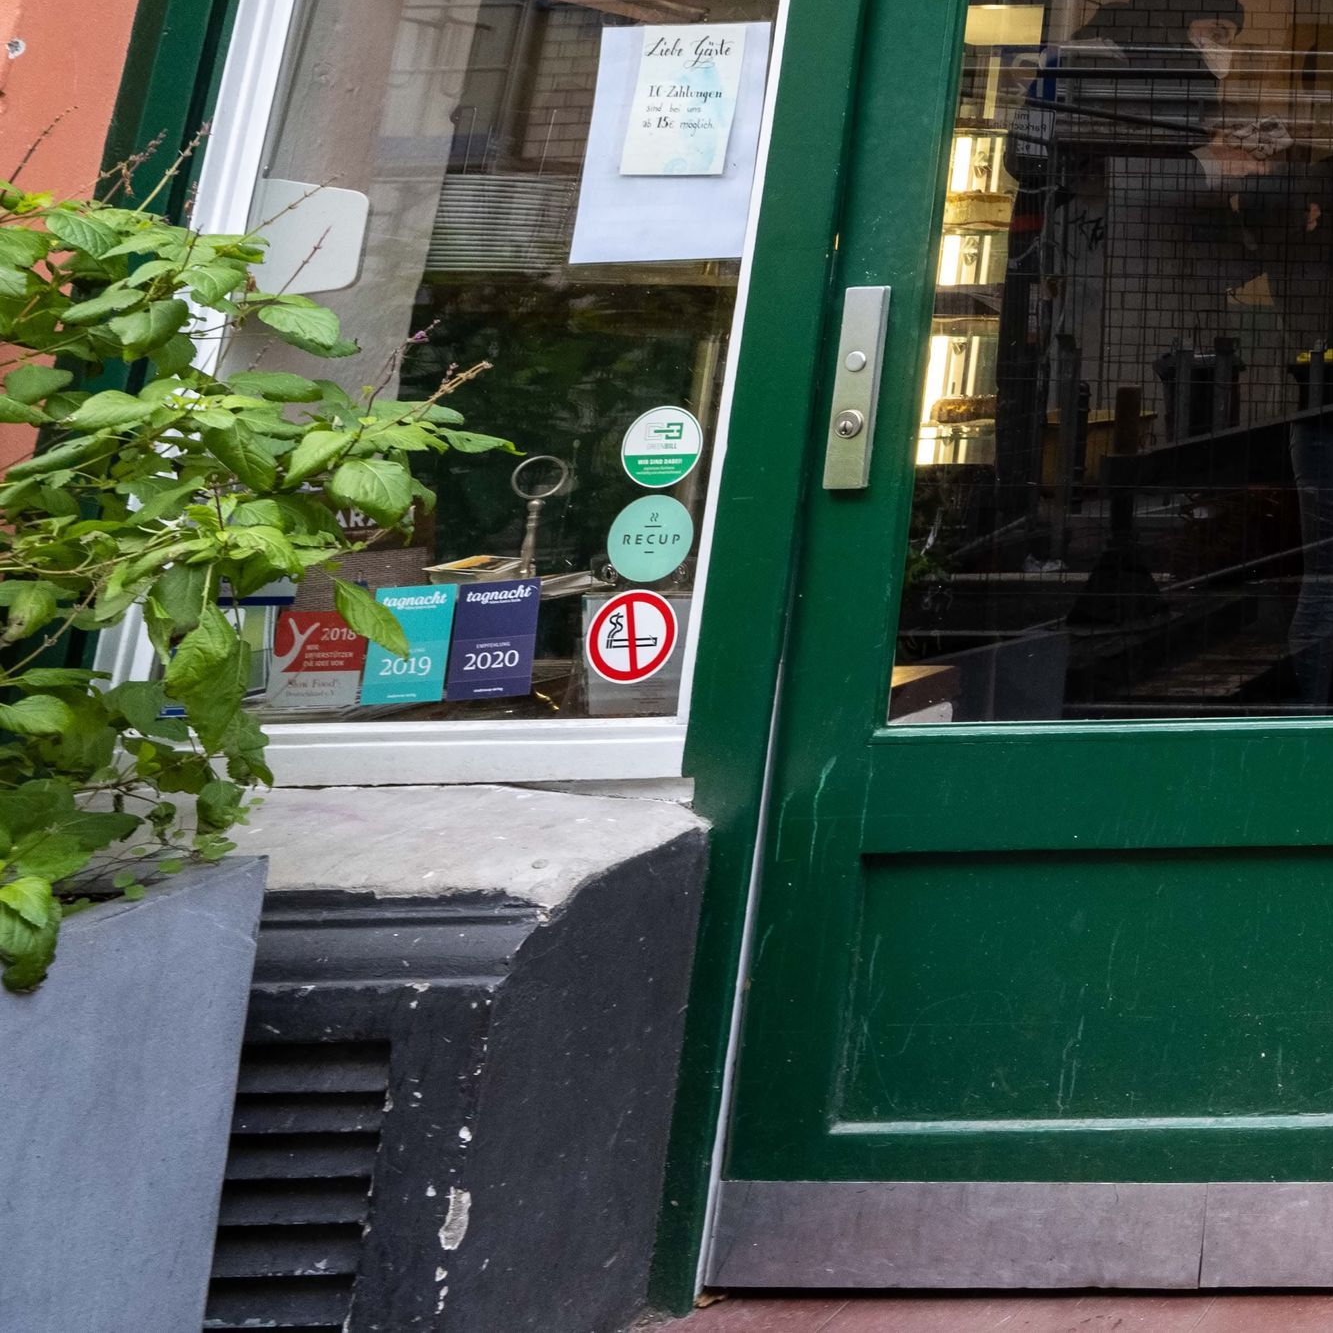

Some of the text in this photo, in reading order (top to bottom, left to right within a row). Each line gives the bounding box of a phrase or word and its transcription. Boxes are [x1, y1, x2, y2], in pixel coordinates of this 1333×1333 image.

[644, 34, 735, 69] Liebe Gäste
[646, 103, 702, 114] sind bei uns
[622, 533, 681, 546] RECUP
[382, 590, 448, 610] tagnacht
[466, 584, 533, 605] tagnacht
[475, 641, 511, 650] EMPFEHLUNG
[379, 656, 432, 676] 2019
[463, 649, 520, 671] 2020
